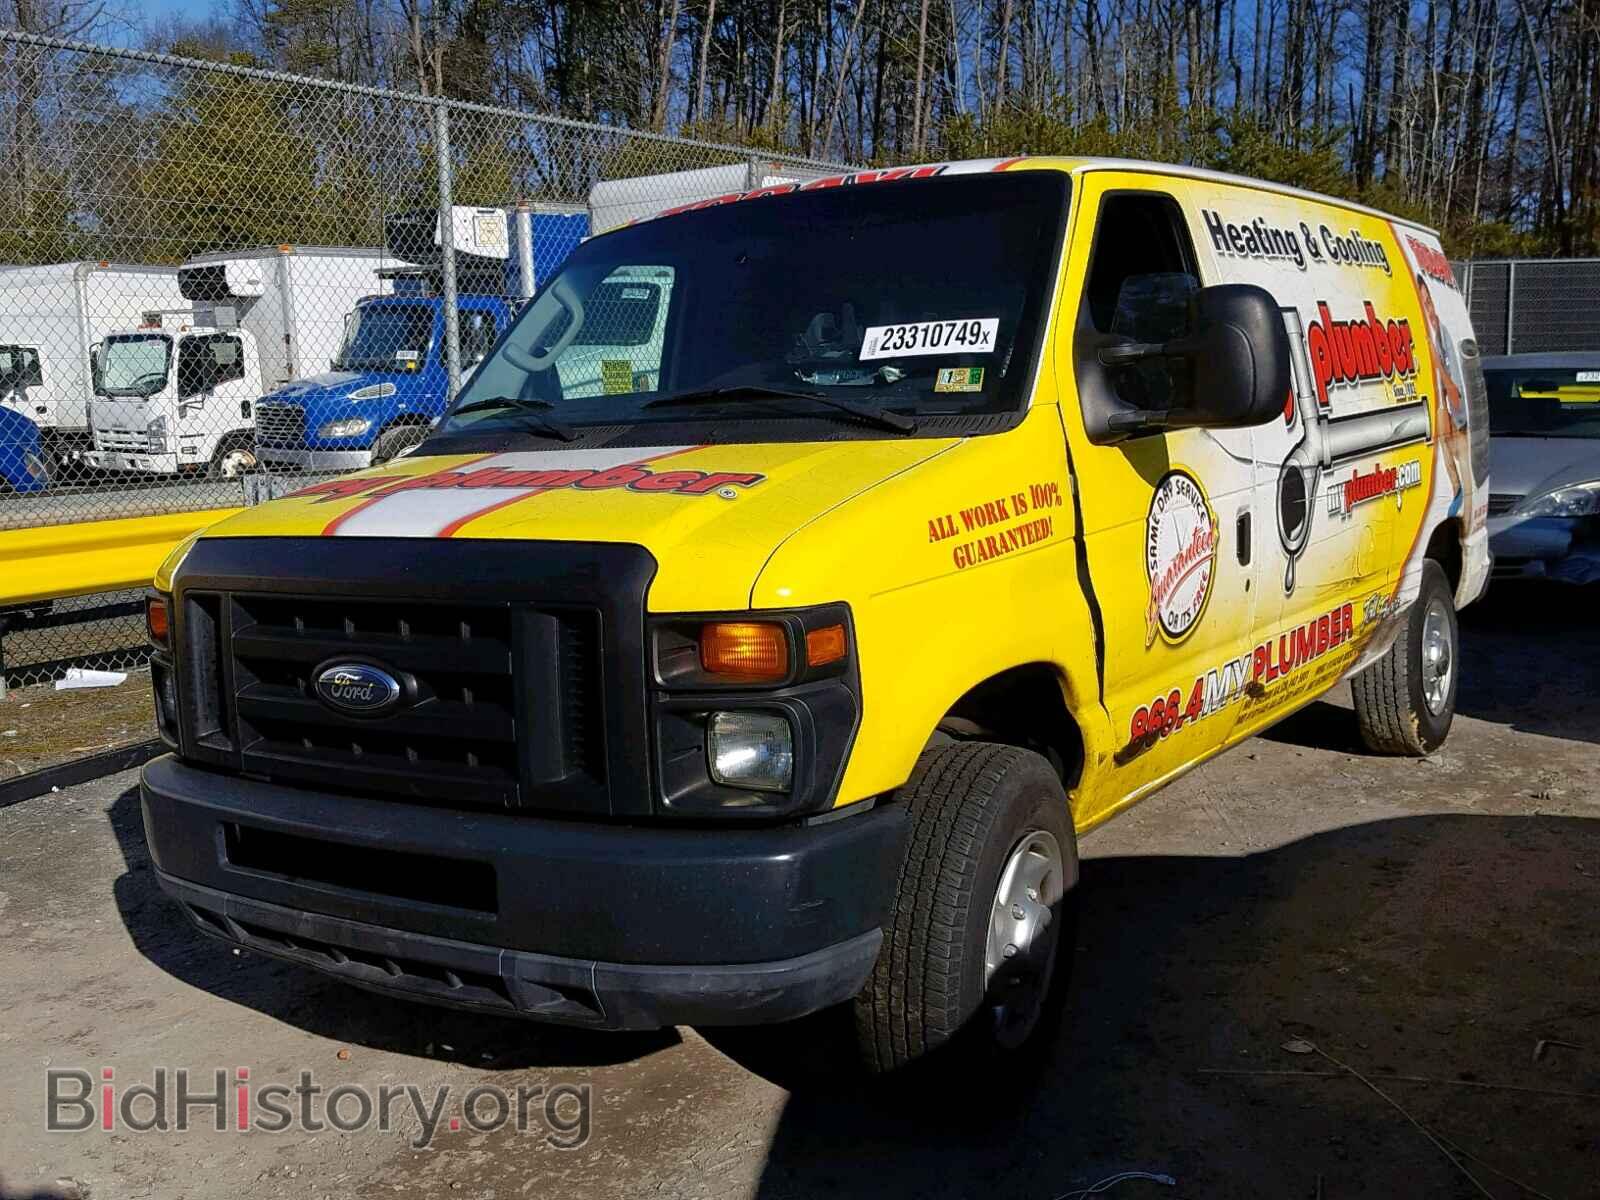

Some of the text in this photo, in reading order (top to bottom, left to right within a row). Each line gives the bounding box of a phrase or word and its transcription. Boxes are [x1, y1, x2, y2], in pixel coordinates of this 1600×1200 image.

[1201, 209, 1304, 268] Heating
[1299, 222, 1322, 258] &
[1319, 224, 1391, 273] Cooling
[1308, 300, 1415, 408] plumber
[361, 464, 767, 498] plumber
[928, 480, 1062, 543] ALL WORK IS 100%
[1327, 460, 1419, 513] myplumber.com
[953, 516, 1053, 569] GUARANTEED!
[1150, 479, 1207, 571] SAME DAY SERVICE
[1145, 518, 1216, 625] Guaranteed
[1168, 570, 1208, 629] OR ITS FREE
[331, 672, 373, 700] Ford
